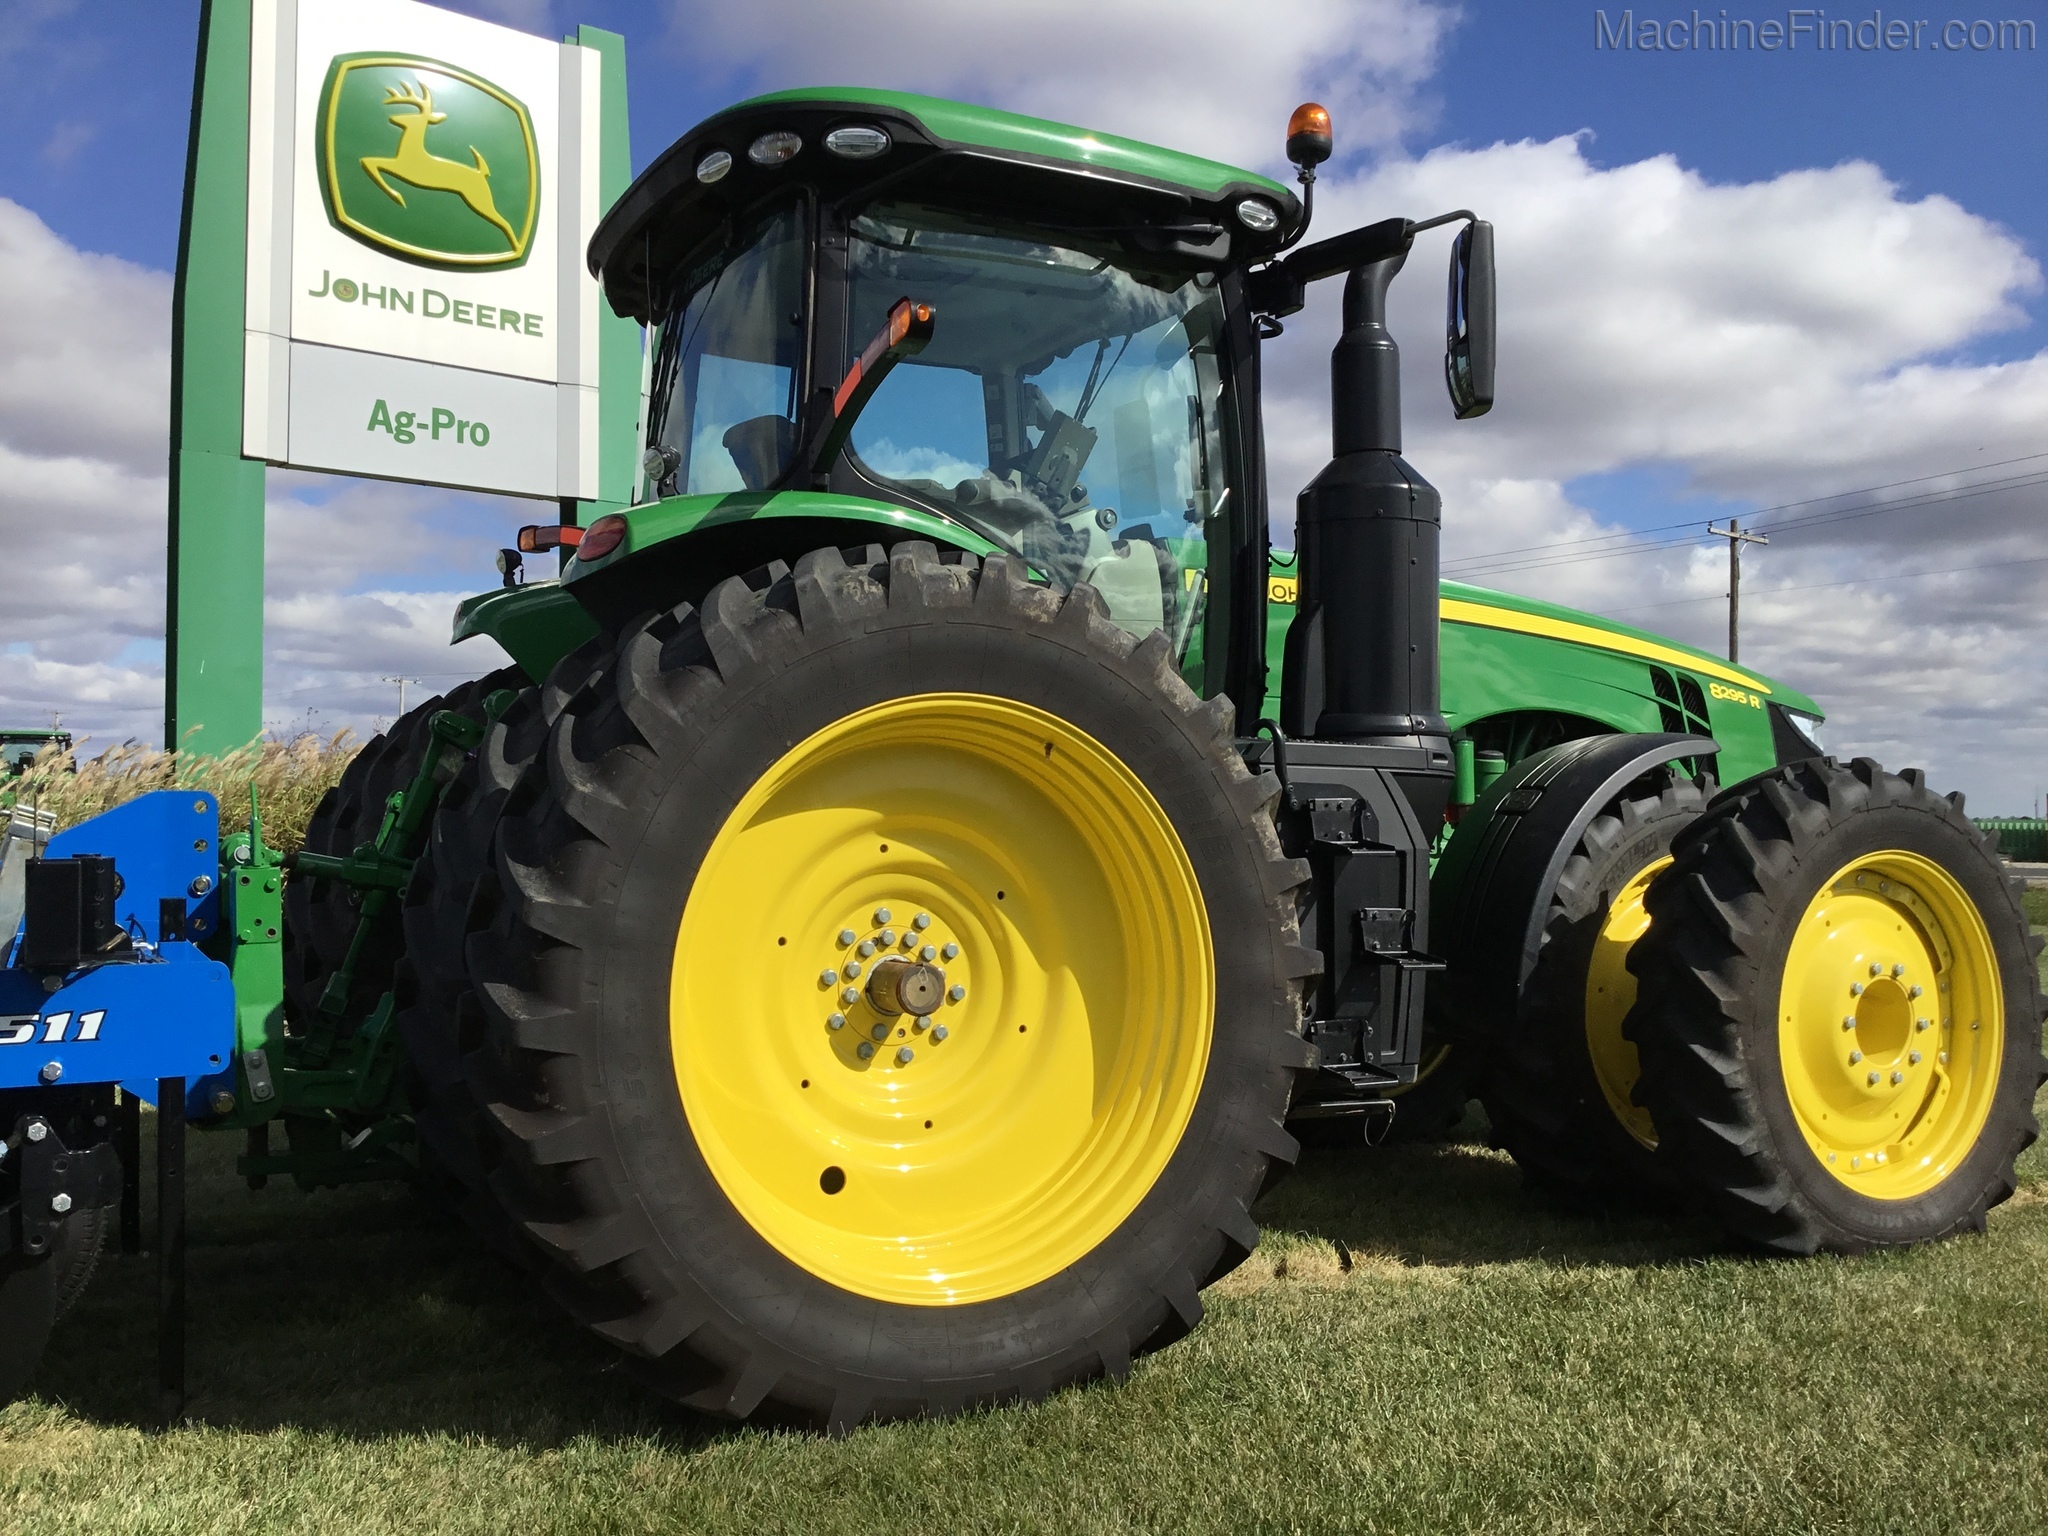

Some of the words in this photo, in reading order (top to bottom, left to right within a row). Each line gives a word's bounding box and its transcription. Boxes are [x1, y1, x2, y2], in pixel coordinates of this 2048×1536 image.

[308, 269, 414, 314] JOHN
[422, 288, 544, 338] DEERE
[366, 398, 490, 447] Ag-Pro
[1267, 584, 1297, 600] OH
[1096, 692, 1237, 870] AGRIBIB
